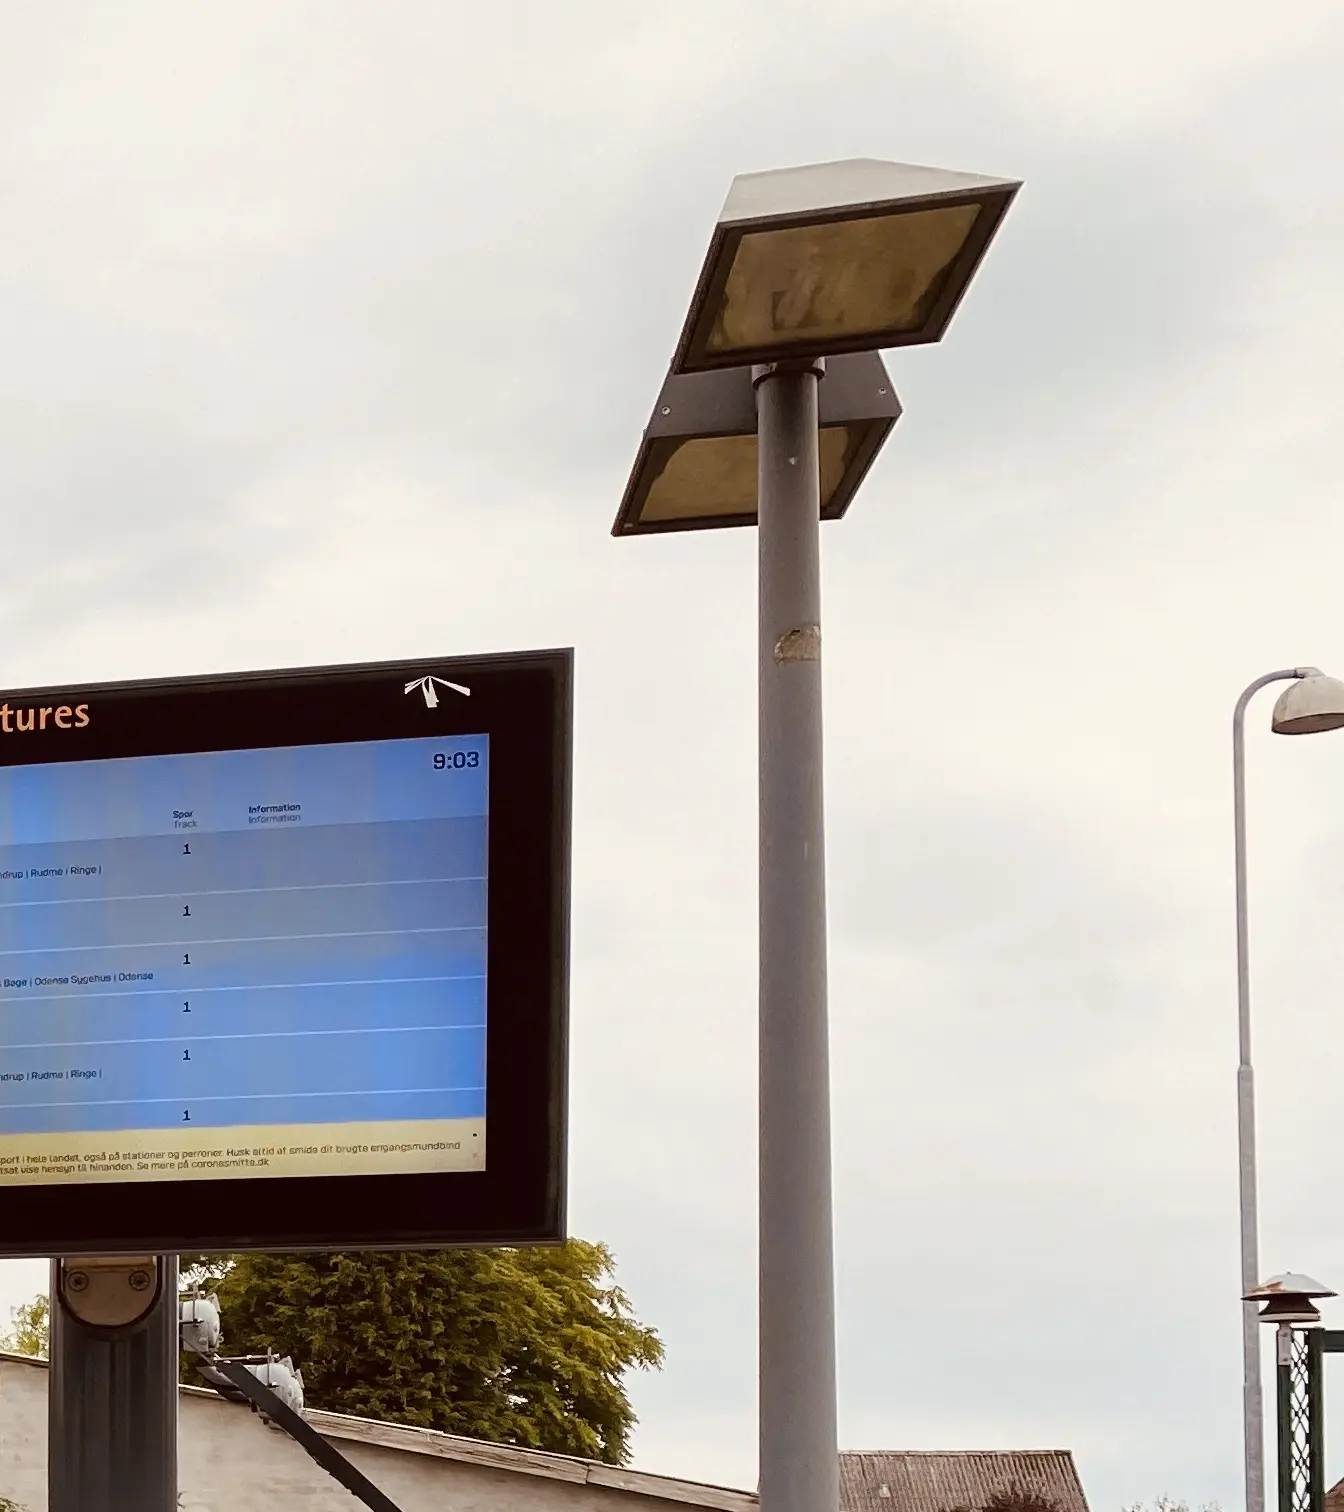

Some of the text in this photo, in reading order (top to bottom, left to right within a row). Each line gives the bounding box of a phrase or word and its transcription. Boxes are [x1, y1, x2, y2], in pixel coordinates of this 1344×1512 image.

[433, 751, 480, 770] 9:03
[248, 803, 301, 813] Information
[173, 809, 193, 819] Spor
[248, 813, 301, 824] Information
[174, 819, 198, 829] Track
[183, 844, 192, 855] 1
[30, 867, 63, 878] Rudme
[70, 865, 97, 877] Ringe
[183, 905, 192, 917] 1
[183, 953, 192, 965] 1
[34, 976, 69, 986] Odense
[71, 974, 112, 985] Sygehus
[118, 972, 154, 982] Odense
[183, 1001, 191, 1012] 1
[183, 1049, 191, 1060] 1
[31, 1070, 63, 1080] Rudme
[70, 1069, 97, 1079] Ringe
[183, 1109, 191, 1120] 1
[26, 1155, 47, 1164] hele
[84, 1152, 107, 1163] også
[108, 1152, 120, 1162] på
[122, 1151, 165, 1161] stationer
[167, 1151, 180, 1161] og
[227, 1147, 250, 1157] Husk
[252, 1146, 275, 1156] altid
[289, 1145, 318, 1155] smide
[320, 1144, 333, 1153] dit
[335, 1144, 368, 1154] brugte
[370, 1141, 461, 1153] engangsmundbind
[21, 1165, 40, 1174] vise
[41, 1164, 76, 1174] hensyn
[136, 1161, 149, 1170] Se
[150, 1161, 175, 1169] mere
[177, 1160, 190, 1170] på
